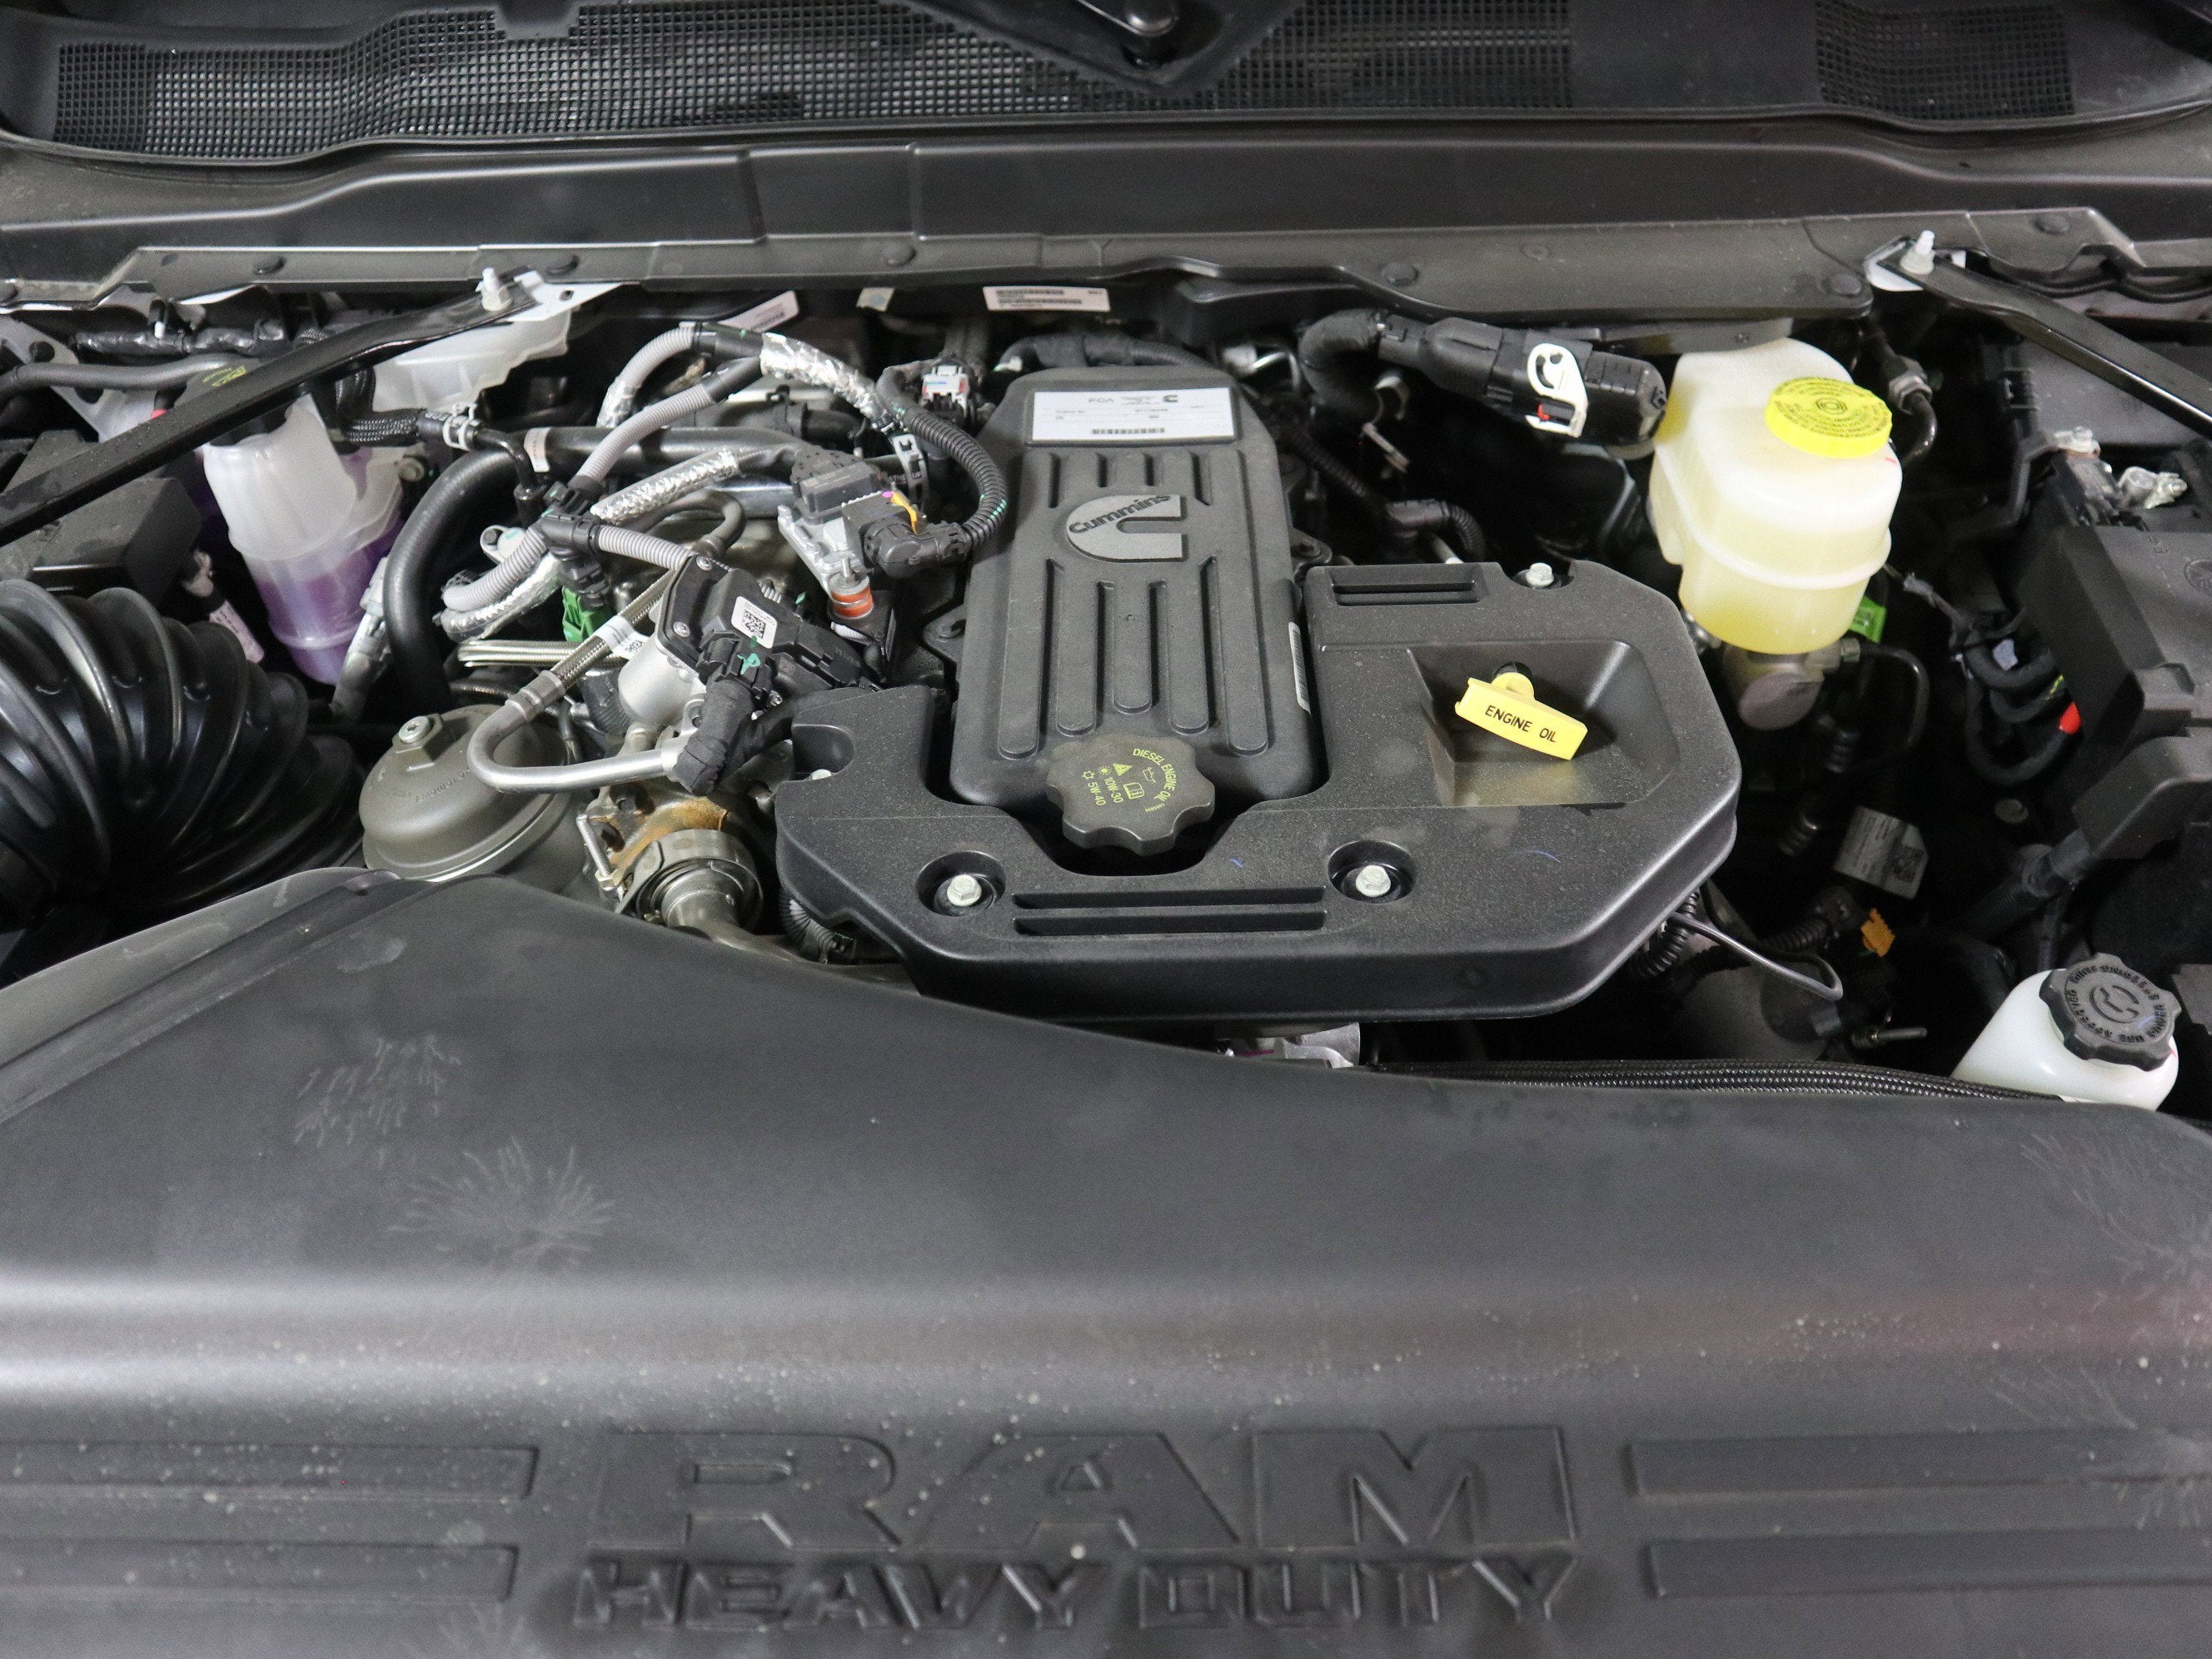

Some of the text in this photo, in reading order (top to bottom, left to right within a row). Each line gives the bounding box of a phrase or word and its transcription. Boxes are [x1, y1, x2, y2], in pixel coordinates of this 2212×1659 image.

[1069, 495, 1171, 534] Cummins
[1485, 705, 1557, 743] ENGINE OIL
[1133, 748, 1165, 766] DIESEL
[1104, 776, 1123, 804] 10W-30
[1161, 763, 1177, 791] ENGINE
[1088, 781, 1106, 806] 5W-40
[1154, 790, 1171, 802] OIL
[586, 1427, 1577, 1552] RAM
[575, 1557, 1579, 1630] HEAVY DUTY
